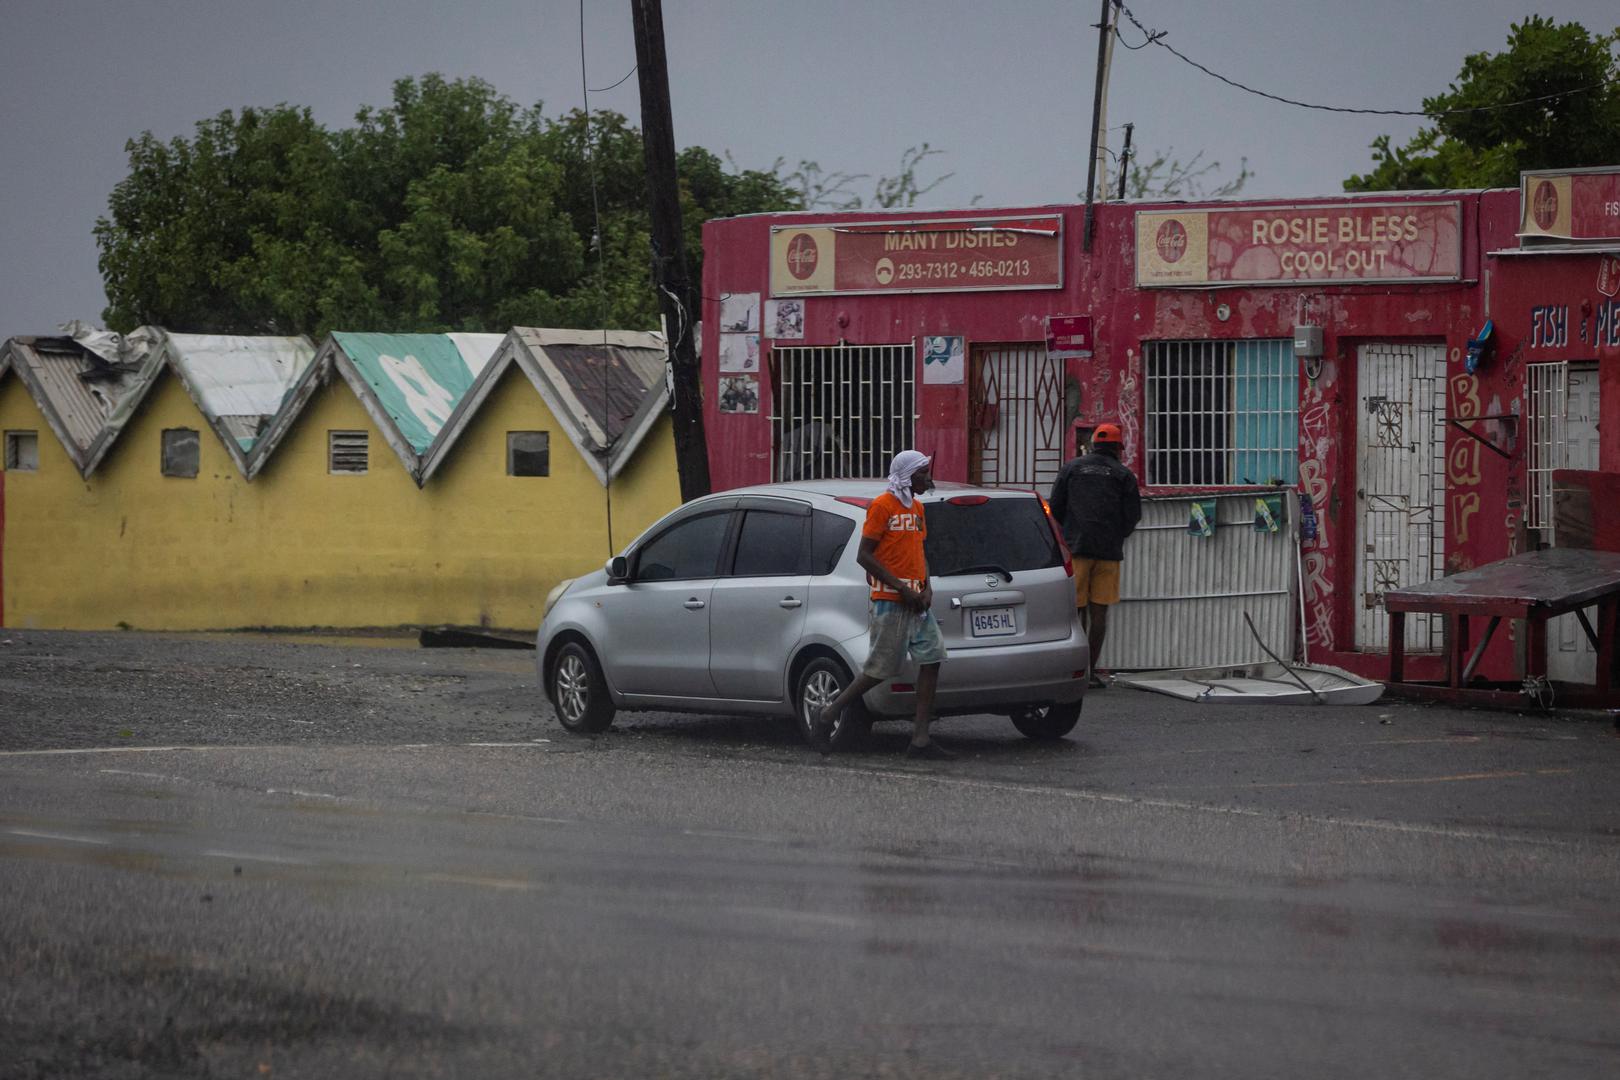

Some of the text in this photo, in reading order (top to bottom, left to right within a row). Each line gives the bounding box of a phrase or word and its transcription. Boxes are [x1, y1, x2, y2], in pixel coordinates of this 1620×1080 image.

[884, 230, 1018, 252] MANY DISHES
[1252, 215, 1419, 245] ROSIE BLESS
[899, 260, 1030, 280] 293-7312 456-0213
[1280, 249, 1389, 272] COOL OUT
[1531, 304, 1568, 348] FISH
